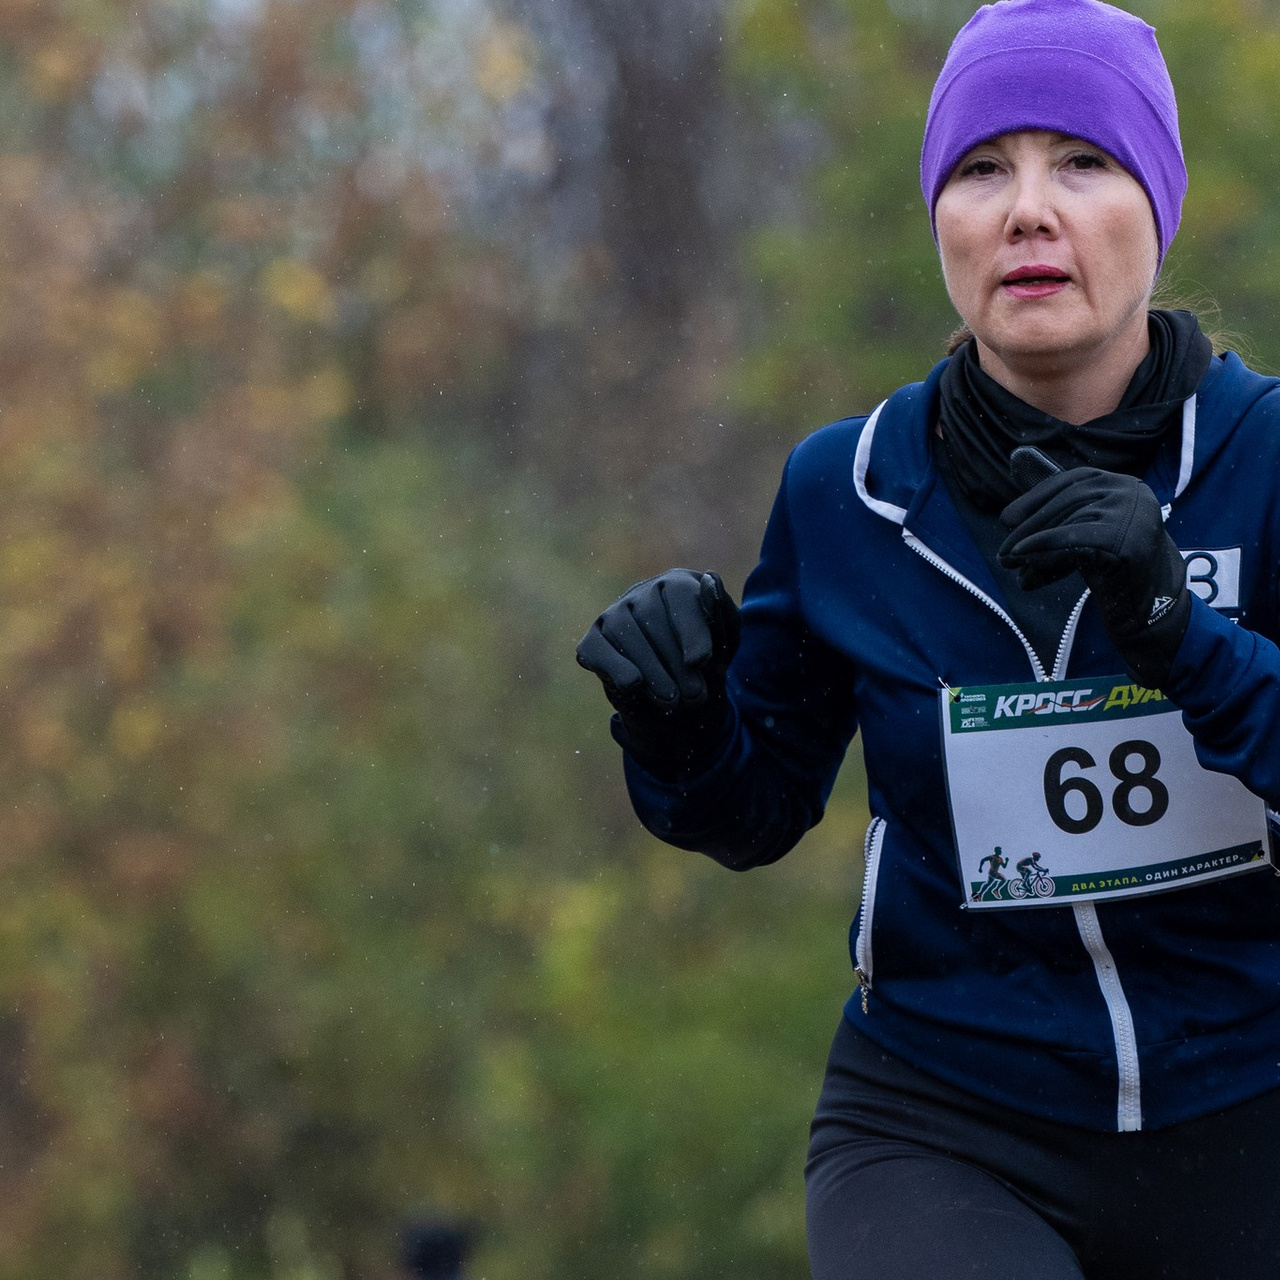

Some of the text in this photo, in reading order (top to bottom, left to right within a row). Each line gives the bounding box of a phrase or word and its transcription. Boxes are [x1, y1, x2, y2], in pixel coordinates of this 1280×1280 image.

[994, 684, 1169, 719] КРОСС ДУА
[1043, 740, 1170, 835] 68
[1072, 855, 1244, 892] ДВА ЭТАПА. ОДИН ХАРАКТЕР.
